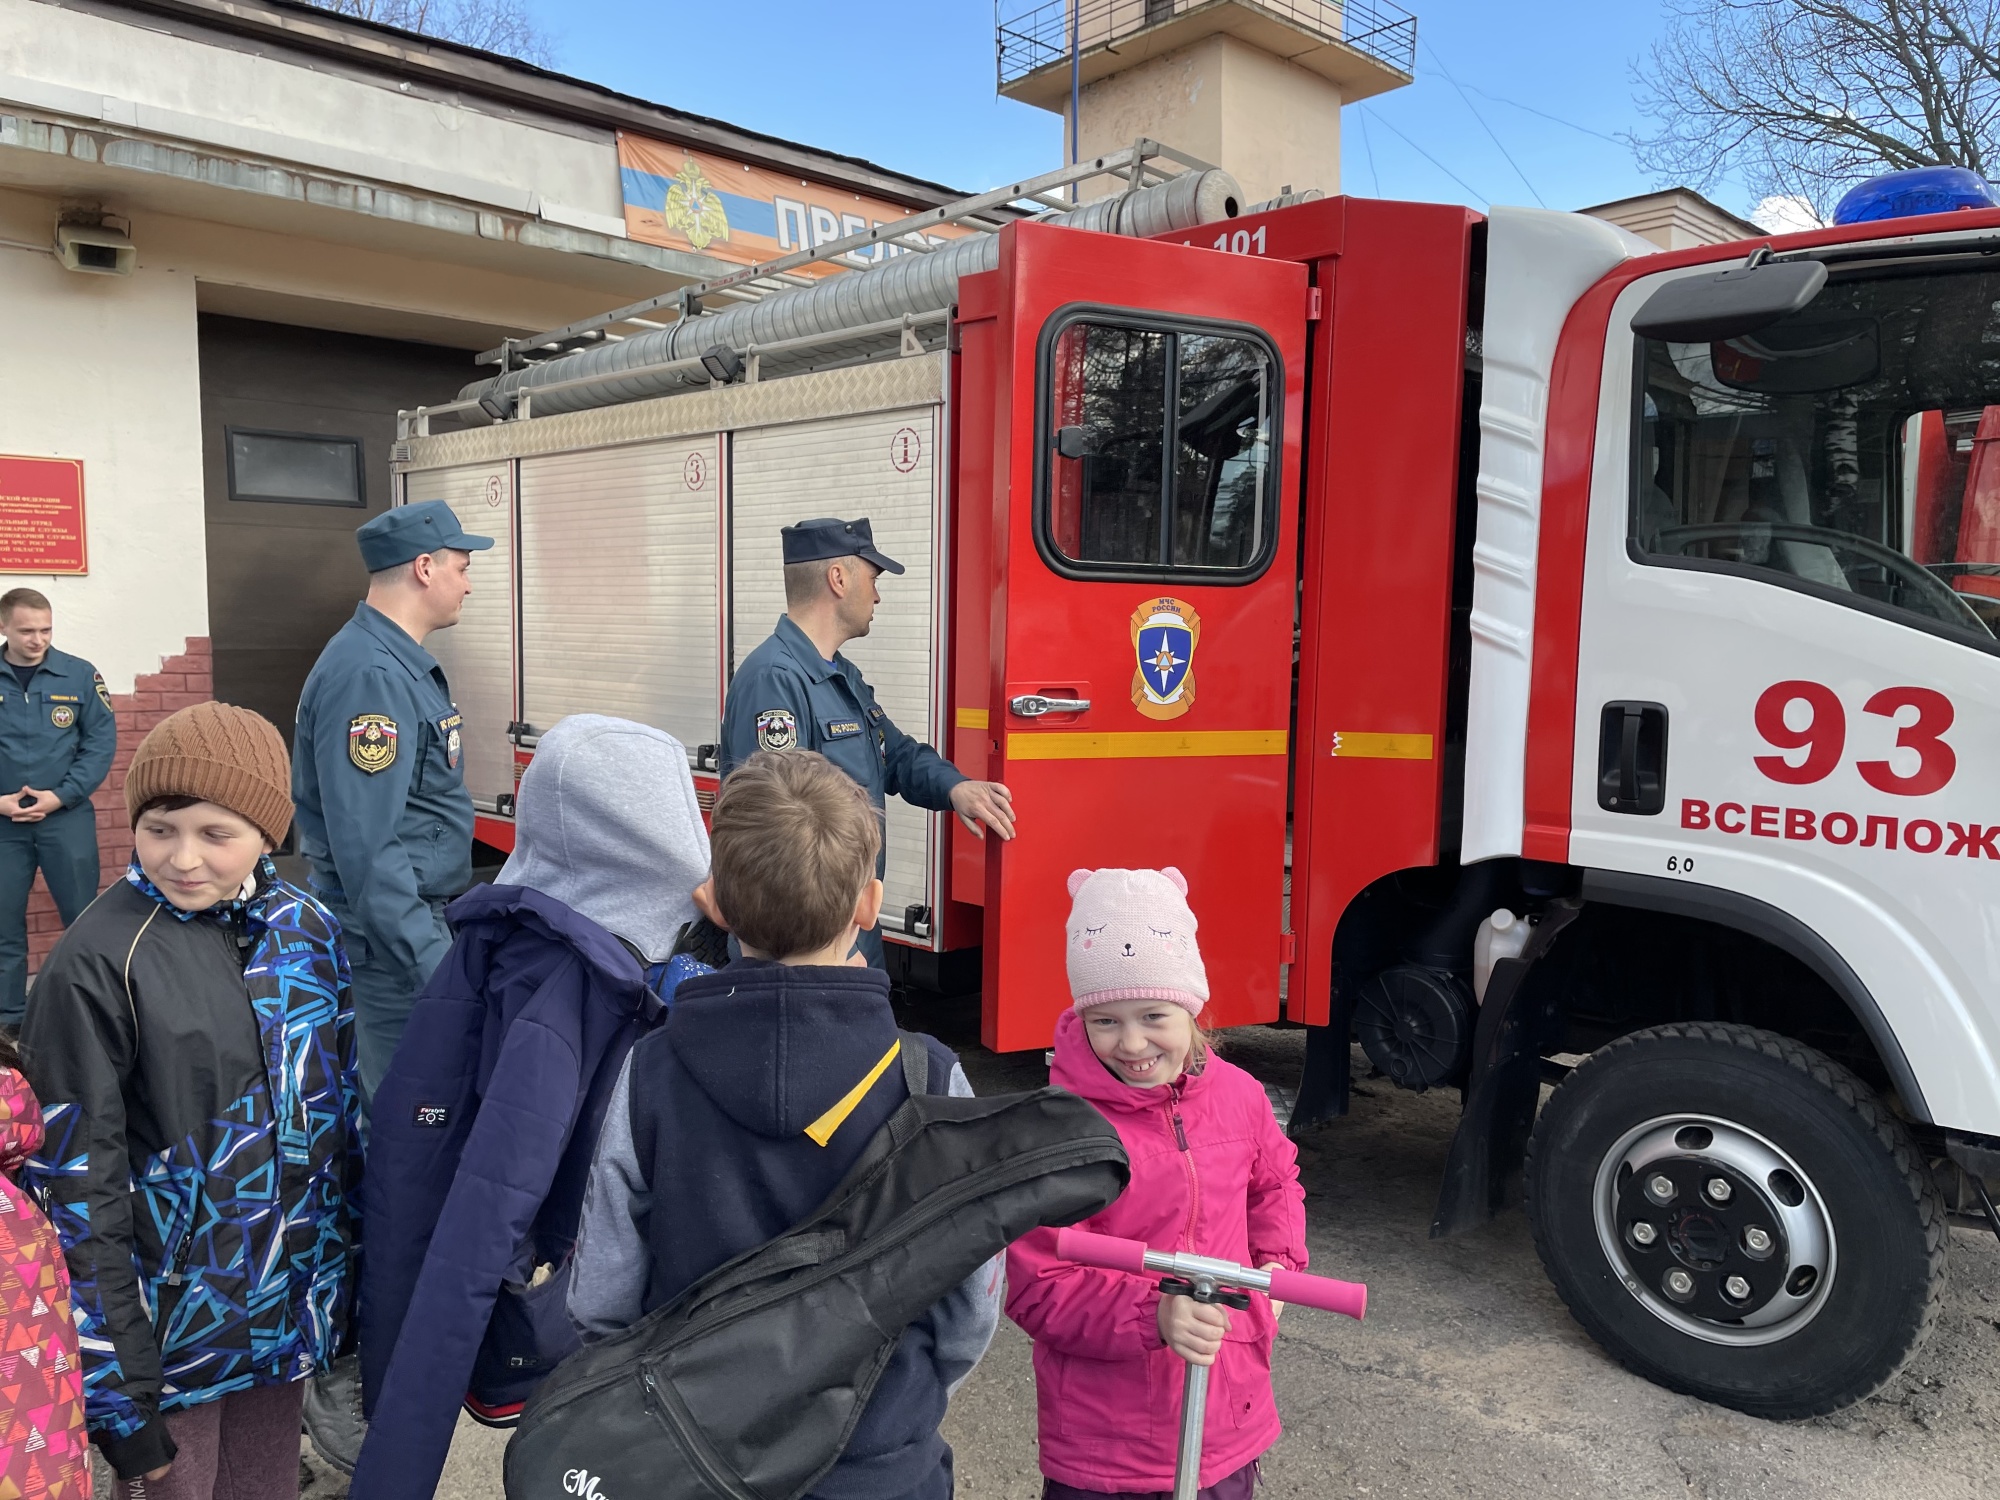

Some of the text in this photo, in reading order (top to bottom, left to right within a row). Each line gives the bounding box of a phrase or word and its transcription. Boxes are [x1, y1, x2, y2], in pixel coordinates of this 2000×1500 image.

[1213, 225, 1266, 255] 101
[1152, 605, 1181, 613] РОССИИ
[1753, 679, 1957, 796] 93
[1680, 798, 2000, 860] ВСЕВОЛОЖ
[1666, 856, 1694, 875] 6,0
